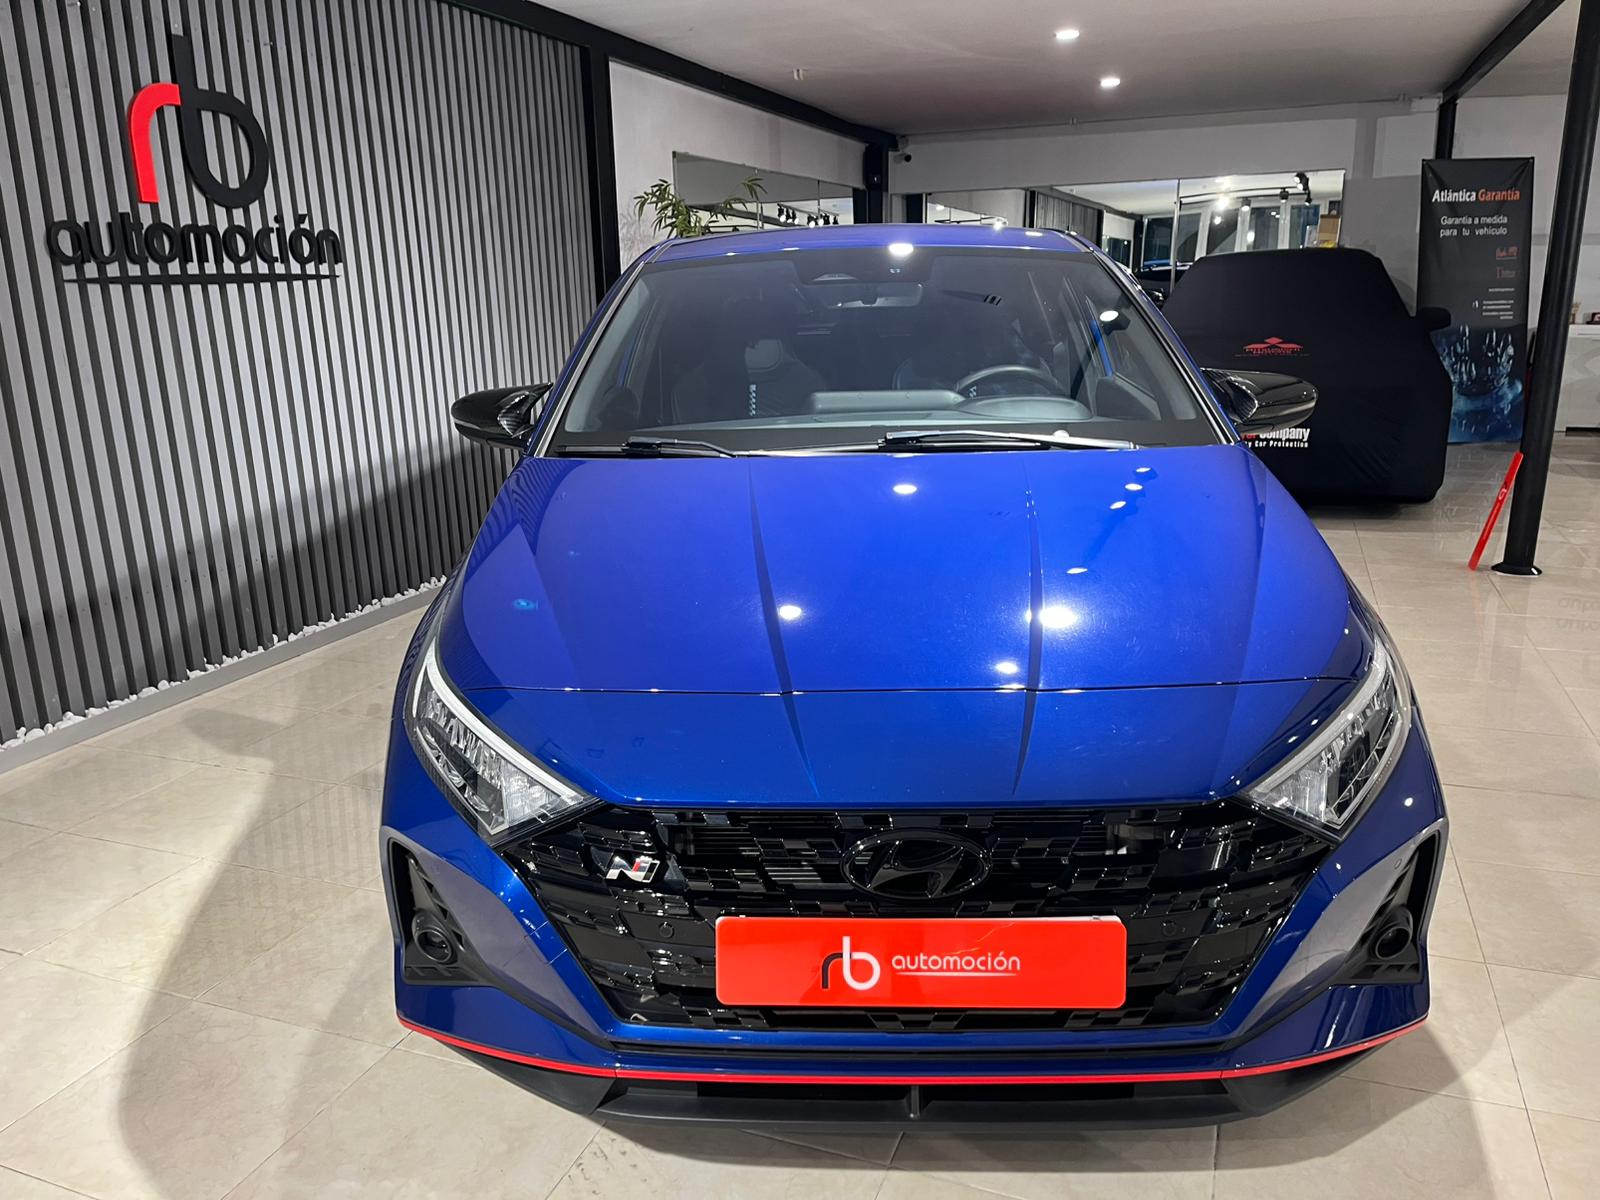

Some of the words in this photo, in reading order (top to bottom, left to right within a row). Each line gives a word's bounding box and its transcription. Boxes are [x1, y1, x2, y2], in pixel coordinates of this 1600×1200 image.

[1432, 189, 1476, 202] Atlántica
[1474, 217, 1479, 225] a
[1480, 214, 1508, 224] medida
[47, 211, 343, 265] automoción
[1440, 229, 1457, 238] para
[1462, 228, 1470, 236] tu
[892, 951, 1020, 971] automoción
